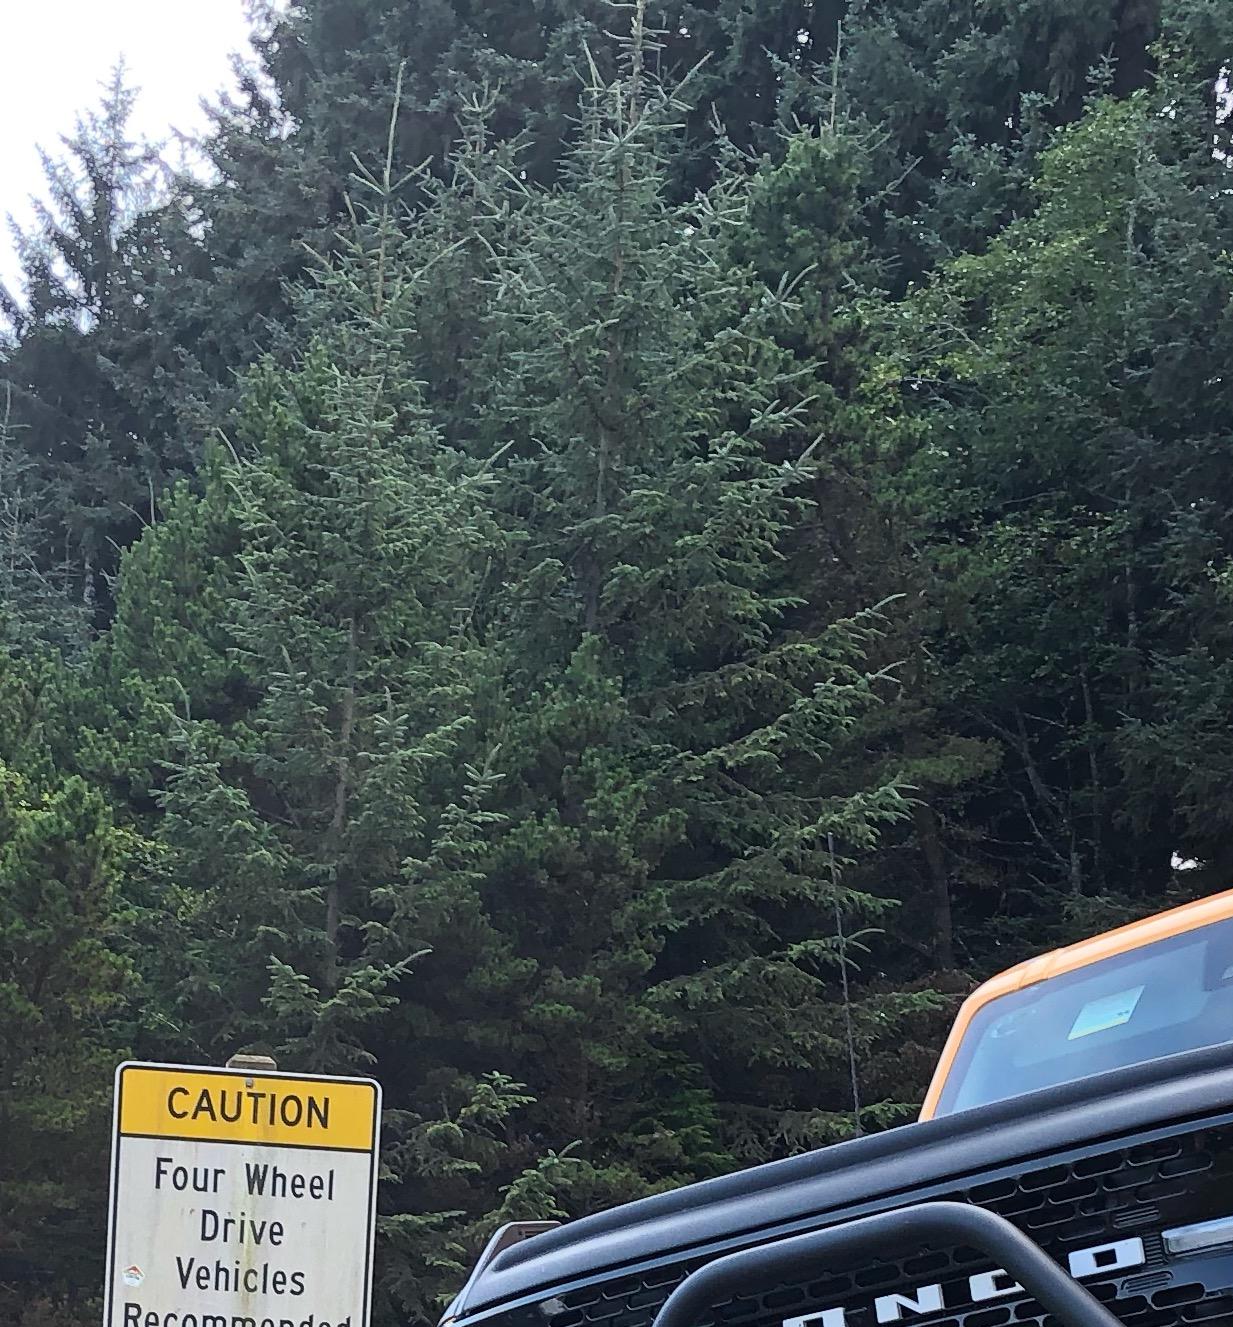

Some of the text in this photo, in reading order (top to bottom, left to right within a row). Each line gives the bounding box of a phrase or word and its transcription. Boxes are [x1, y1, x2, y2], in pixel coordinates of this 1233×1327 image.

[167, 1086, 330, 1129] CAUTION
[154, 1157, 334, 1201] Four Wheel
[200, 1209, 285, 1246] Drive
[176, 1256, 305, 1296] Vehicles
